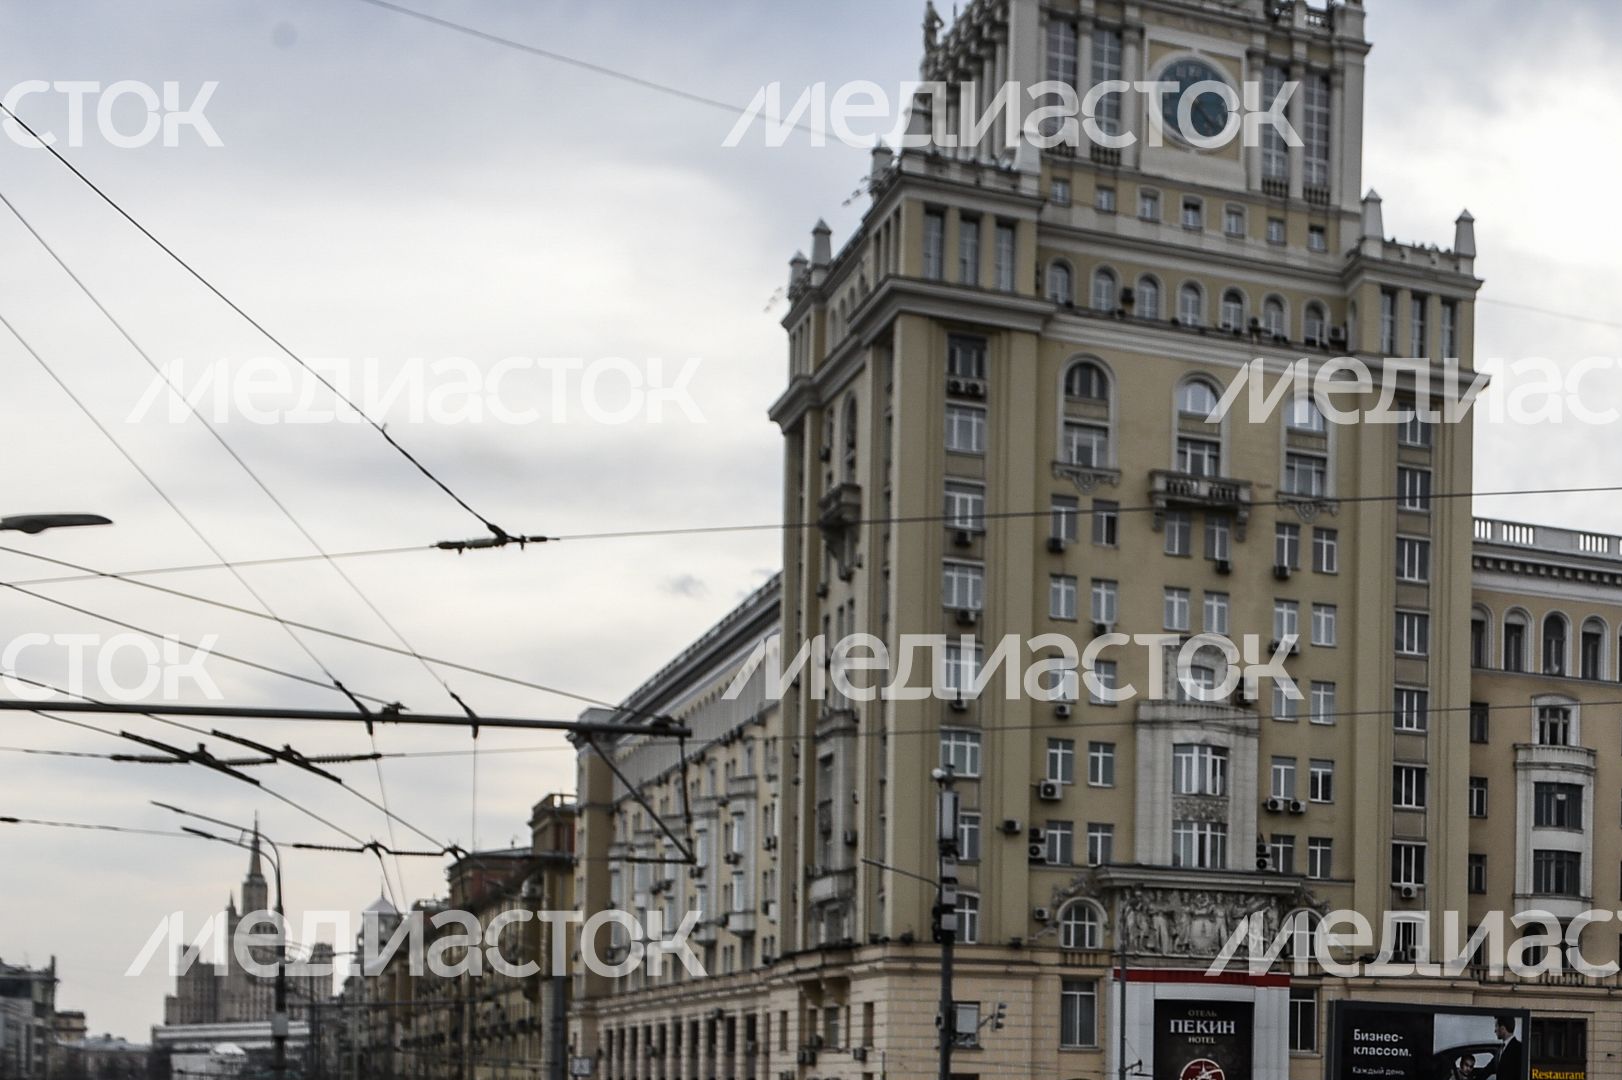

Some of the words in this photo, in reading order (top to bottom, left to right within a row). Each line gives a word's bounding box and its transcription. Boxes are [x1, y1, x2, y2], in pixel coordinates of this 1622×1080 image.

[1187, 1009, 1217, 1017] ОТЕЛЬ
[1170, 1019, 1235, 1035] ПЕКИН
[1188, 1036, 1217, 1045] HOTEL
[1353, 1028, 1404, 1043] Бизнес-
[1353, 1046, 1412, 1058] классом.
[1352, 1066, 1384, 1076] Каждый
[1385, 1068, 1405, 1077] день
[1531, 1068, 1585, 1080] Restaurant
